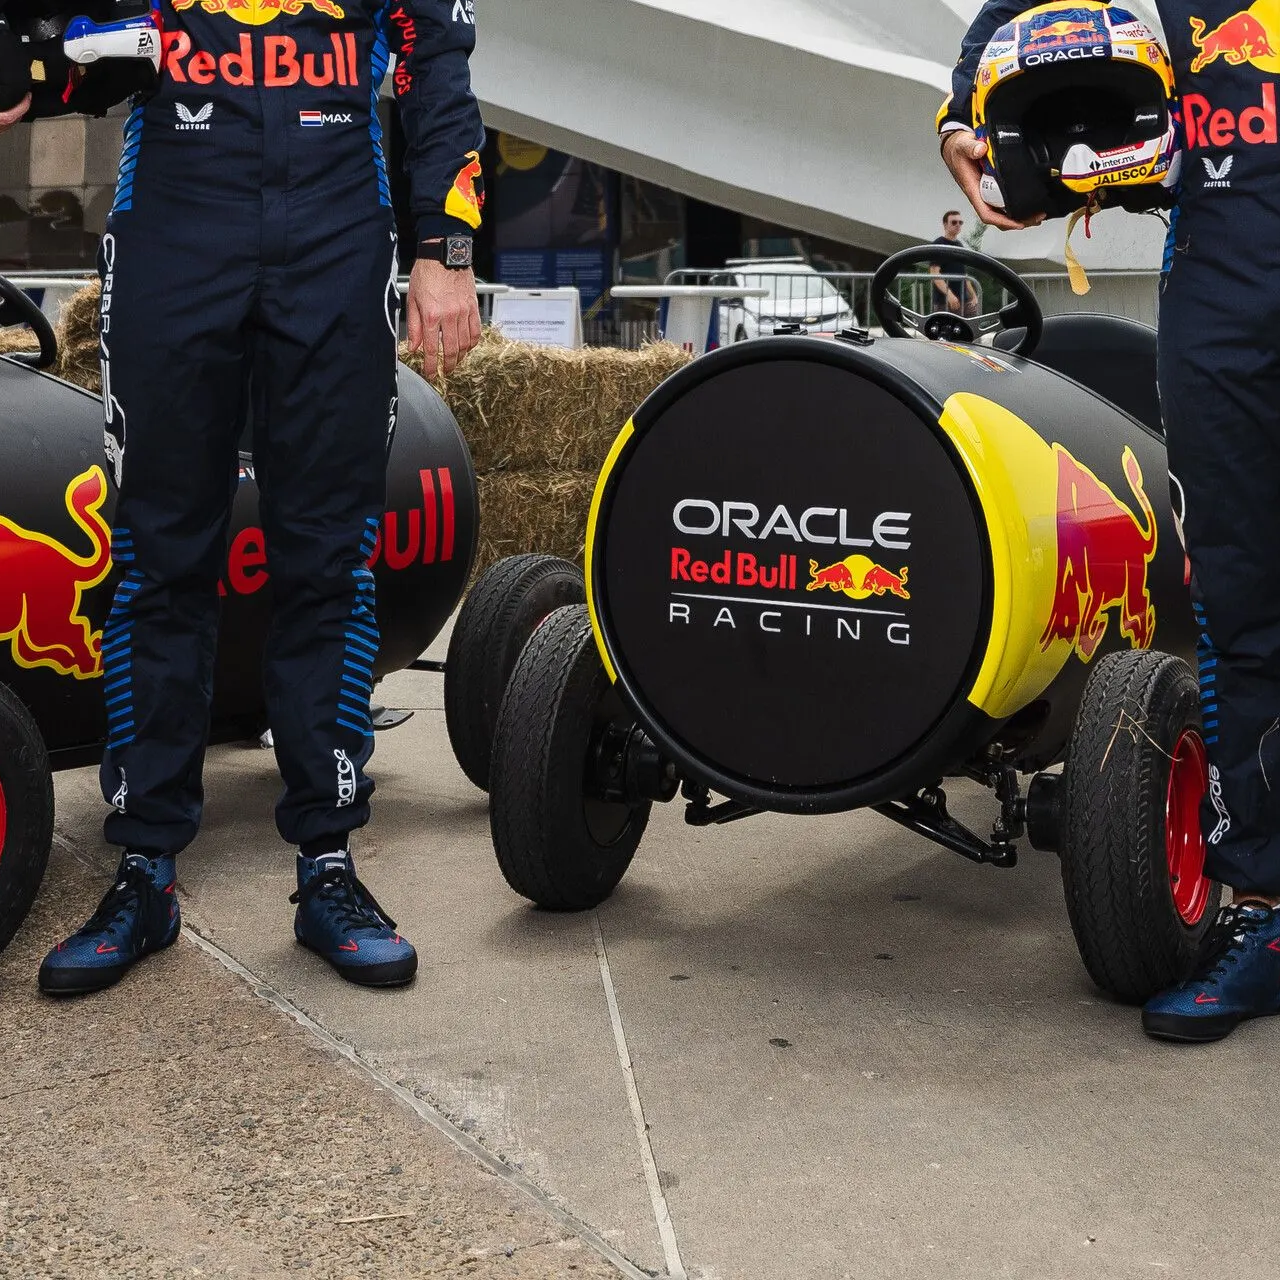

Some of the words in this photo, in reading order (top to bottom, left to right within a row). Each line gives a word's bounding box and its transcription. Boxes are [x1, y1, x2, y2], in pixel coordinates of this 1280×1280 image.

[138, 33, 154, 48] EA
[1065, 33, 1105, 45] Bull
[136, 47, 154, 56] SPORTS
[163, 30, 254, 87] Red
[264, 32, 359, 87] Bull
[1025, 45, 1105, 66] ORACLE
[322, 113, 353, 124] MAX
[1182, 82, 1277, 151] Red
[1102, 155, 1136, 168] inter.mx
[1094, 166, 1147, 186] JALISCO
[1203, 177, 1231, 188] CASTORE
[673, 499, 912, 550] ORACLE
[671, 547, 732, 584] Red
[736, 552, 797, 590] Bull
[669, 603, 911, 645] RACING
[1209, 763, 1231, 845] sparco
